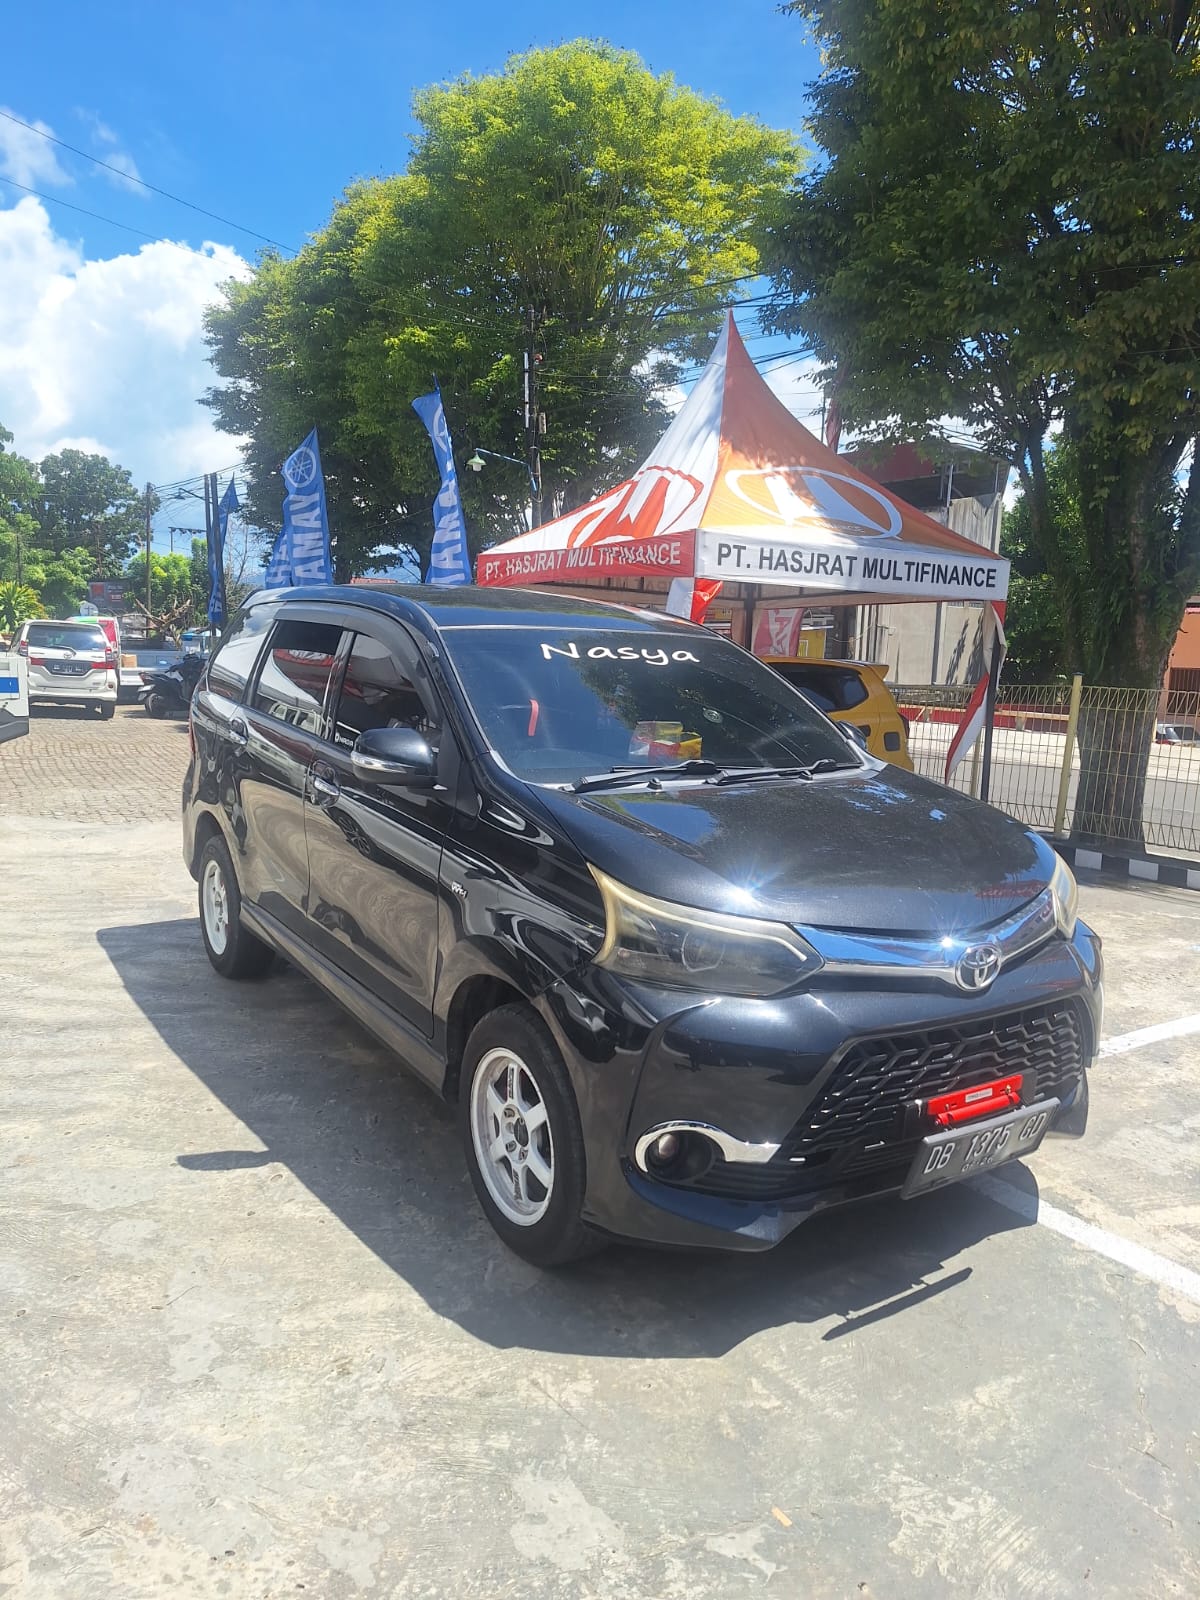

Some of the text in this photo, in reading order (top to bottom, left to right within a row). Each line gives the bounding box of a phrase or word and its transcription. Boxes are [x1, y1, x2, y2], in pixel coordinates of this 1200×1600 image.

[486, 541, 681, 580] PT. HASJRAT MULTIFINANCE
[717, 543, 997, 588] PT. HASJRAT MULTIFINANCE
[540, 642, 701, 666] Nasya
[924, 1113, 1047, 1174] DB 1375 GD
